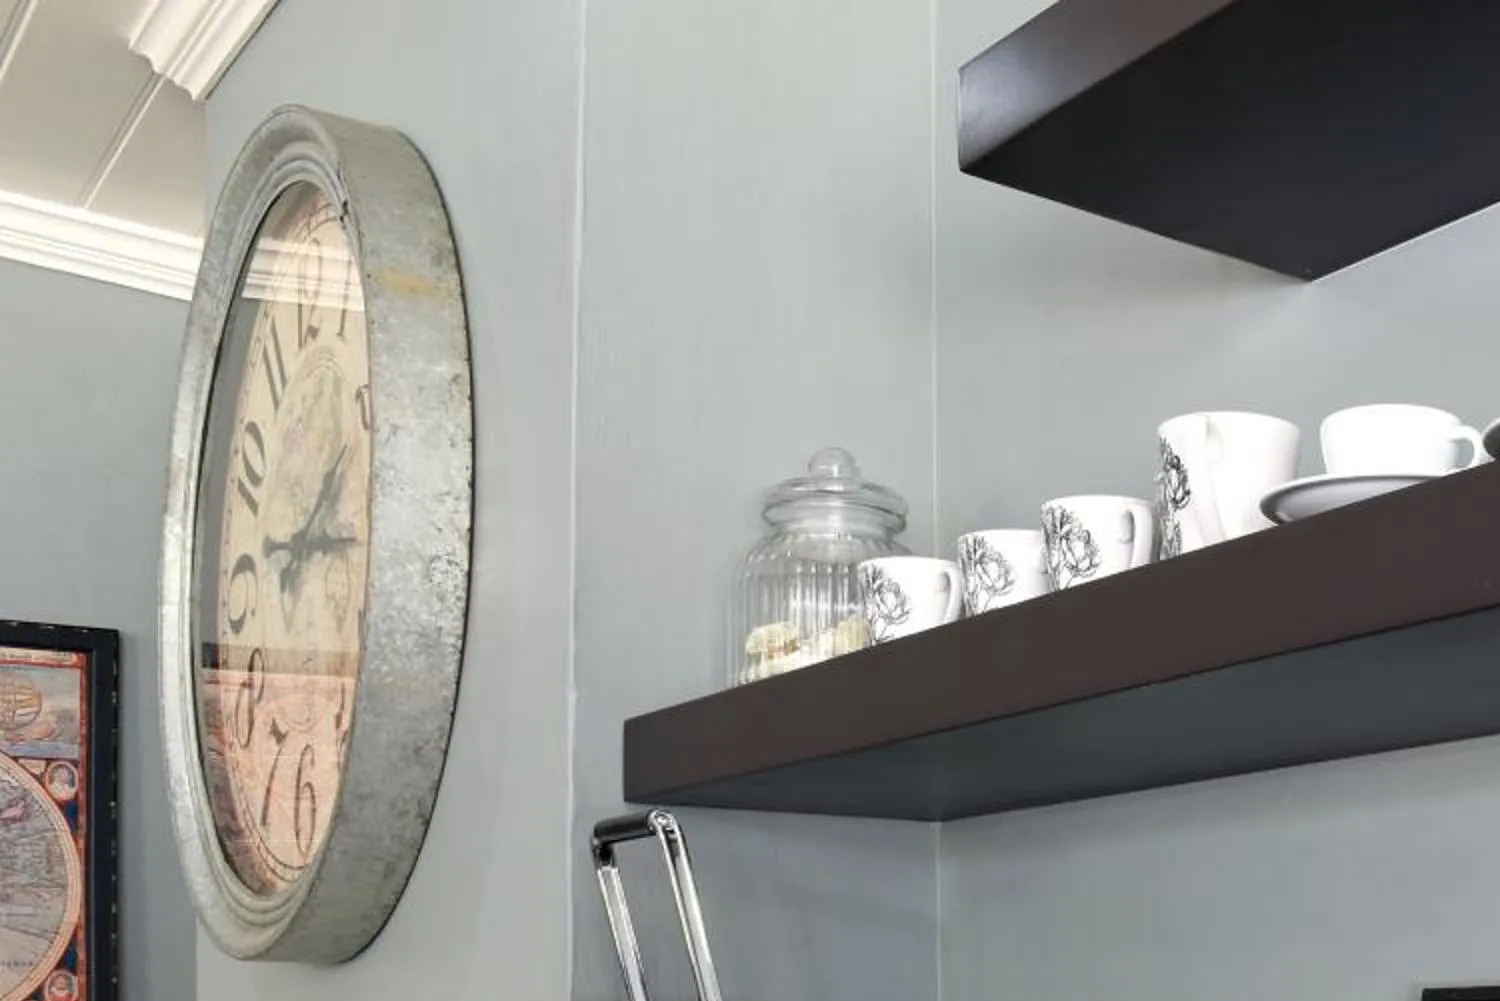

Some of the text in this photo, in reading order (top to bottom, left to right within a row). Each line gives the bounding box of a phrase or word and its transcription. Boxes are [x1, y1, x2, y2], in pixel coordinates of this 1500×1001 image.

[237, 420, 265, 518] 10
[227, 553, 258, 636] 9
[235, 647, 265, 749] 8
[294, 744, 317, 861] 6
